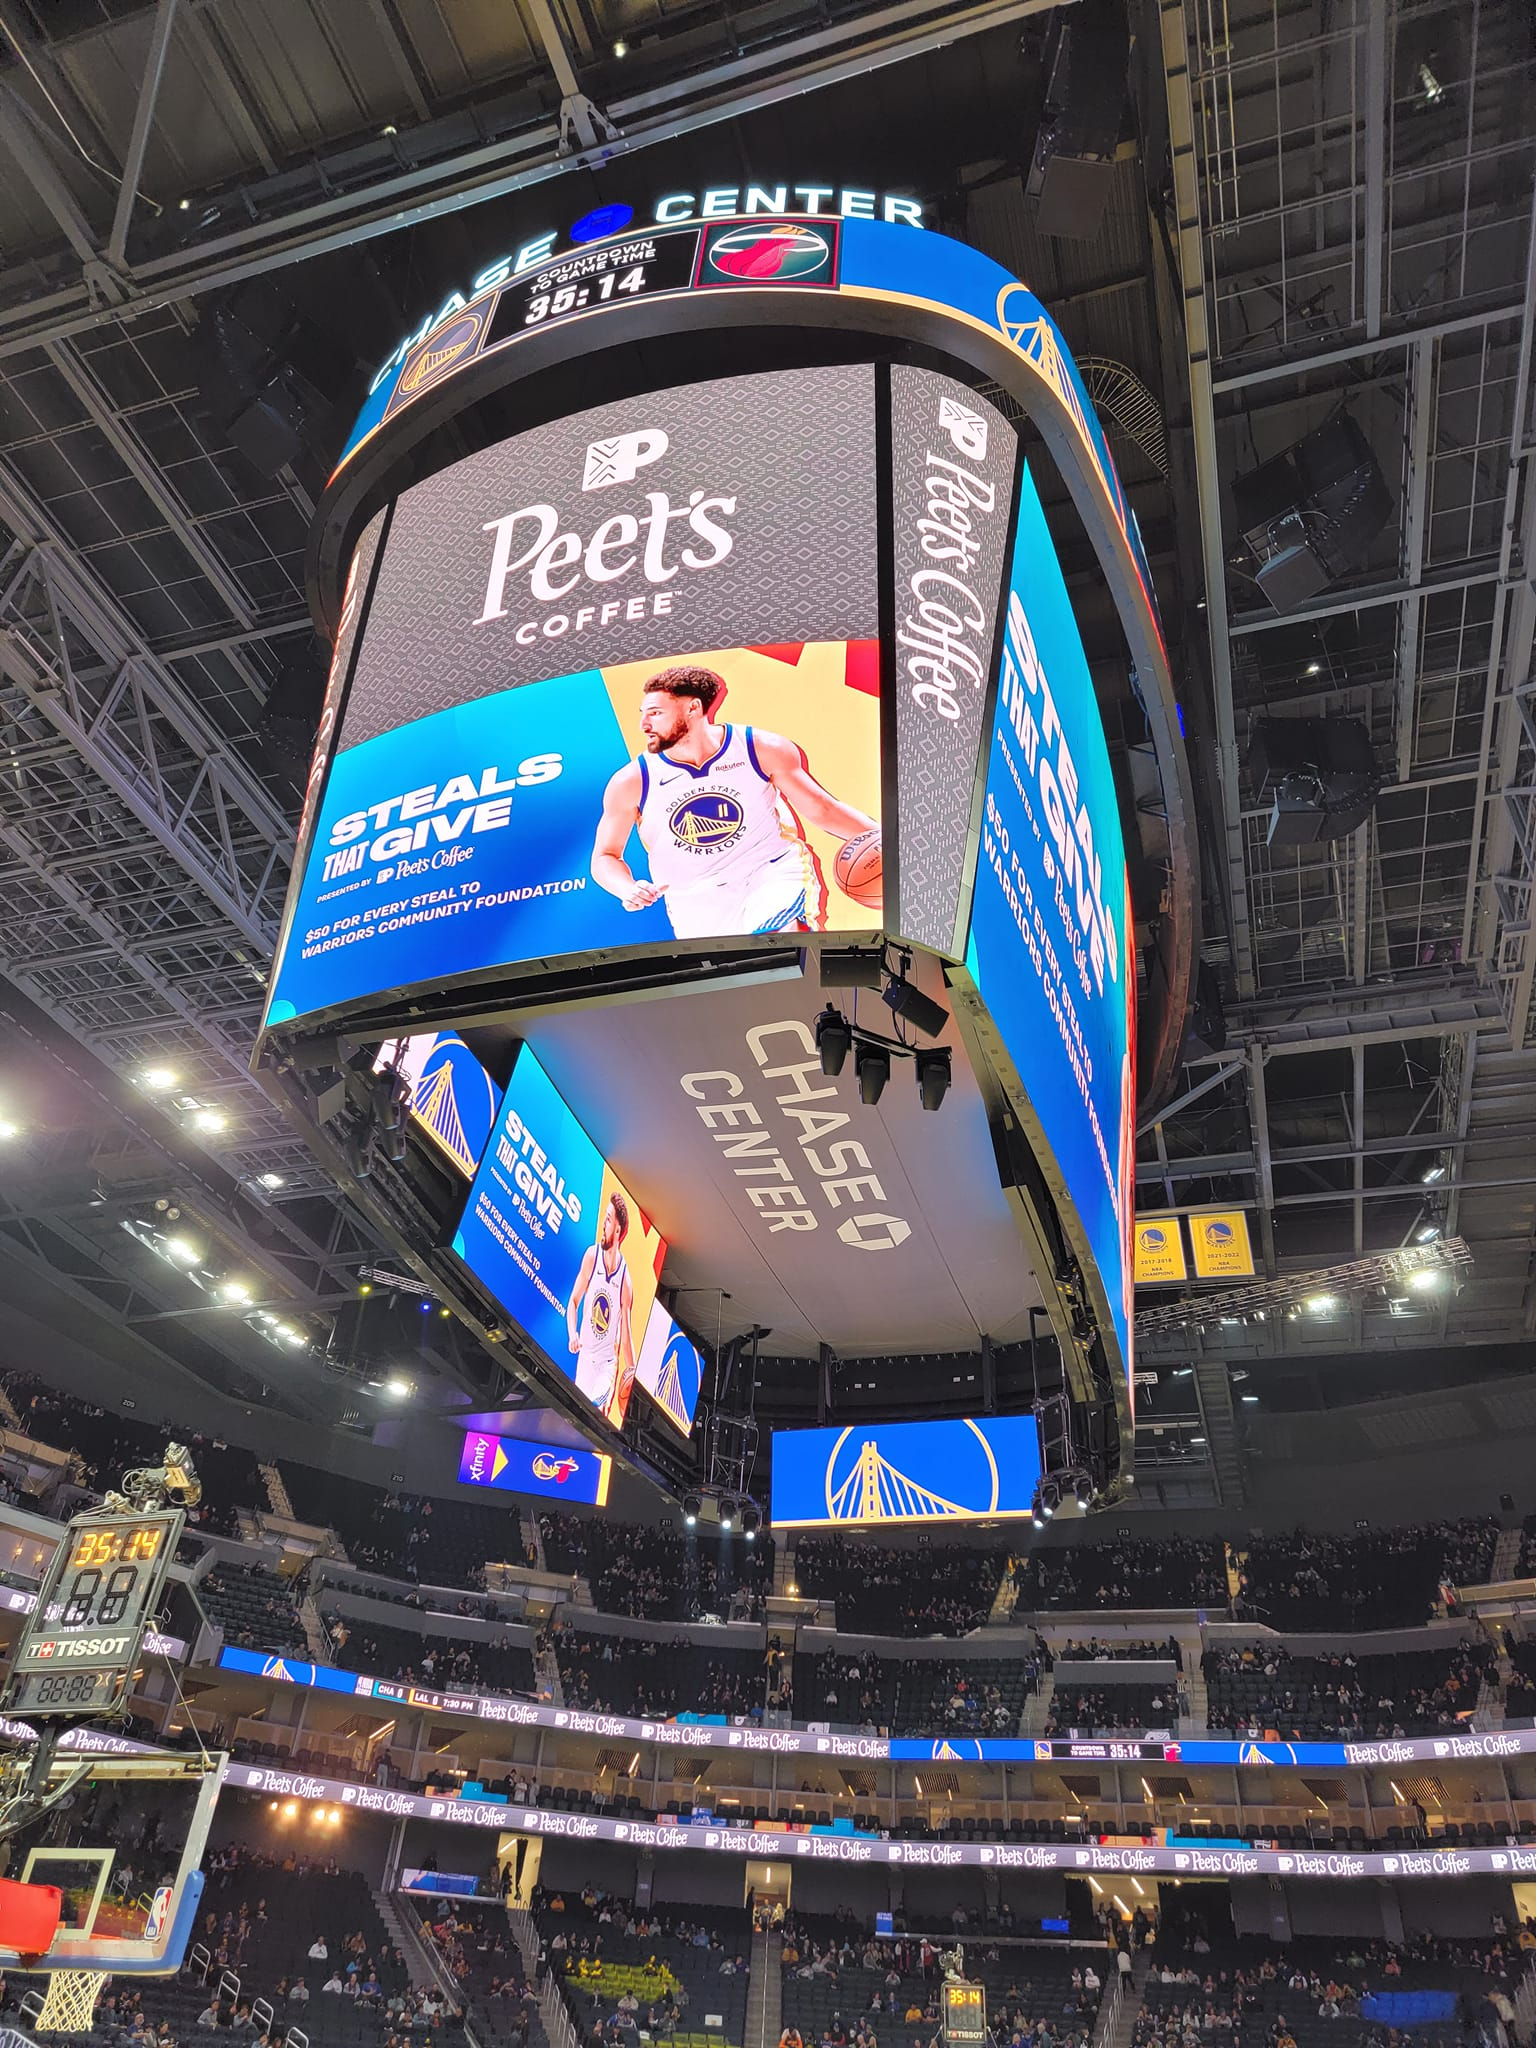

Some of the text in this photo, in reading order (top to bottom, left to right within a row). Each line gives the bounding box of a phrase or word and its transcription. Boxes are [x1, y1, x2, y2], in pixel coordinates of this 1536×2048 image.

[369, 186, 926, 396] CHASE CENTER
[530, 248, 656, 294] TO GAME TIME
[537, 241, 654, 282] COUNTDOWN
[524, 266, 646, 325] 35:14
[472, 489, 737, 627] Peet's
[715, 761, 746, 772] Rakuten
[1007, 589, 1118, 984] STEALS
[329, 752, 564, 847] STEALS
[665, 785, 742, 814] GOLDEN STATE
[1001, 643, 1105, 998] THAT GIVE
[322, 796, 513, 882] THAT GIVE
[673, 824, 748, 856] WARRIORS
[316, 882, 360, 903] PRESENTED
[360, 878, 372, 889] BY
[432, 846, 474, 872] Coffee
[301, 877, 588, 960] WARRIORS COMMUNITY FOUNDATION
[305, 881, 481, 944] $50 FOR EVERY STEAL TO
[986, 792, 1094, 1083] $50 FOR EVERY STEAL TO
[984, 824, 1043, 977] WARRIORS
[1043, 971, 1091, 1107] COMMUNITY
[679, 1020, 888, 1233] CHASE CENTER
[495, 1134, 564, 1235] THAT GIVE
[505, 1109, 583, 1223] STEALS
[479, 1190, 541, 1271] $50 FOR EVERY STEAL TO
[475, 1203, 567, 1318] WARRIORS COMMUNITY FOUNDATION
[469, 1438, 489, 1481] xfinity
[75, 1528, 160, 1566] 35:14
[57, 1636, 131, 1657] TISSOT
[378, 1686, 395, 1696] CHA
[414, 1692, 429, 1704] LAL
[442, 1699, 474, 1711] 7:30 PM
[1110, 1744, 1141, 1758] 35:14
[950, 1989, 980, 2005] 35:14
[958, 2030, 984, 2039] TISSOT
